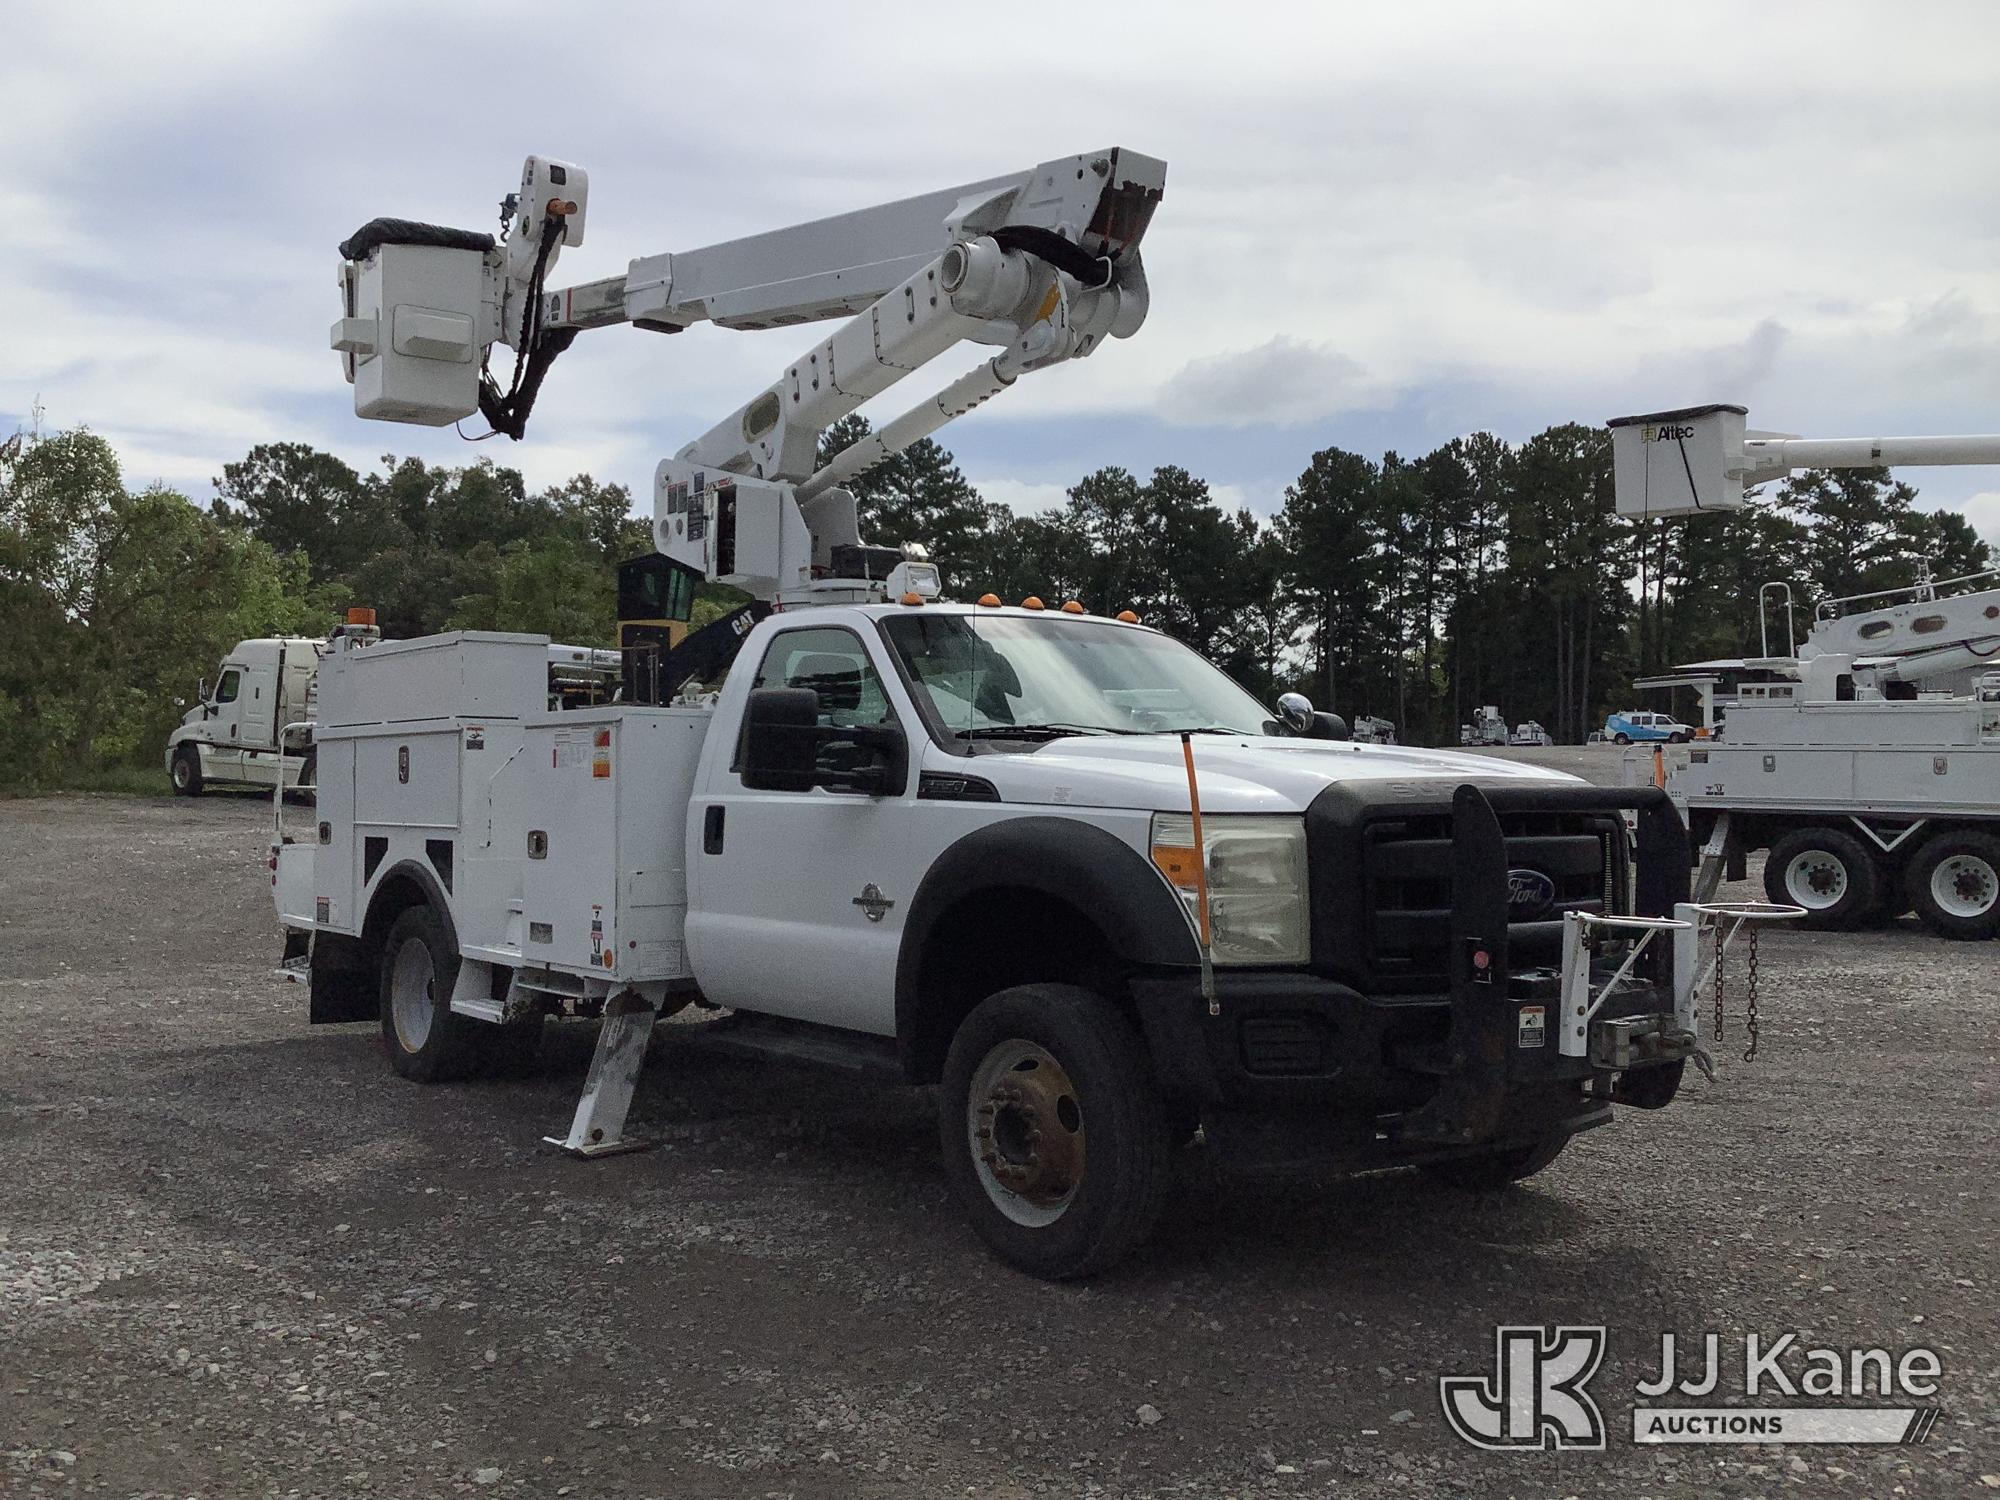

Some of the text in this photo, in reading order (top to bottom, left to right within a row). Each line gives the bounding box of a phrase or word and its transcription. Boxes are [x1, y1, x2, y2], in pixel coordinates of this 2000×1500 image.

[1657, 425, 1695, 442] Altec
[731, 609, 755, 635] CAT
[1506, 877, 1543, 904] Ford
